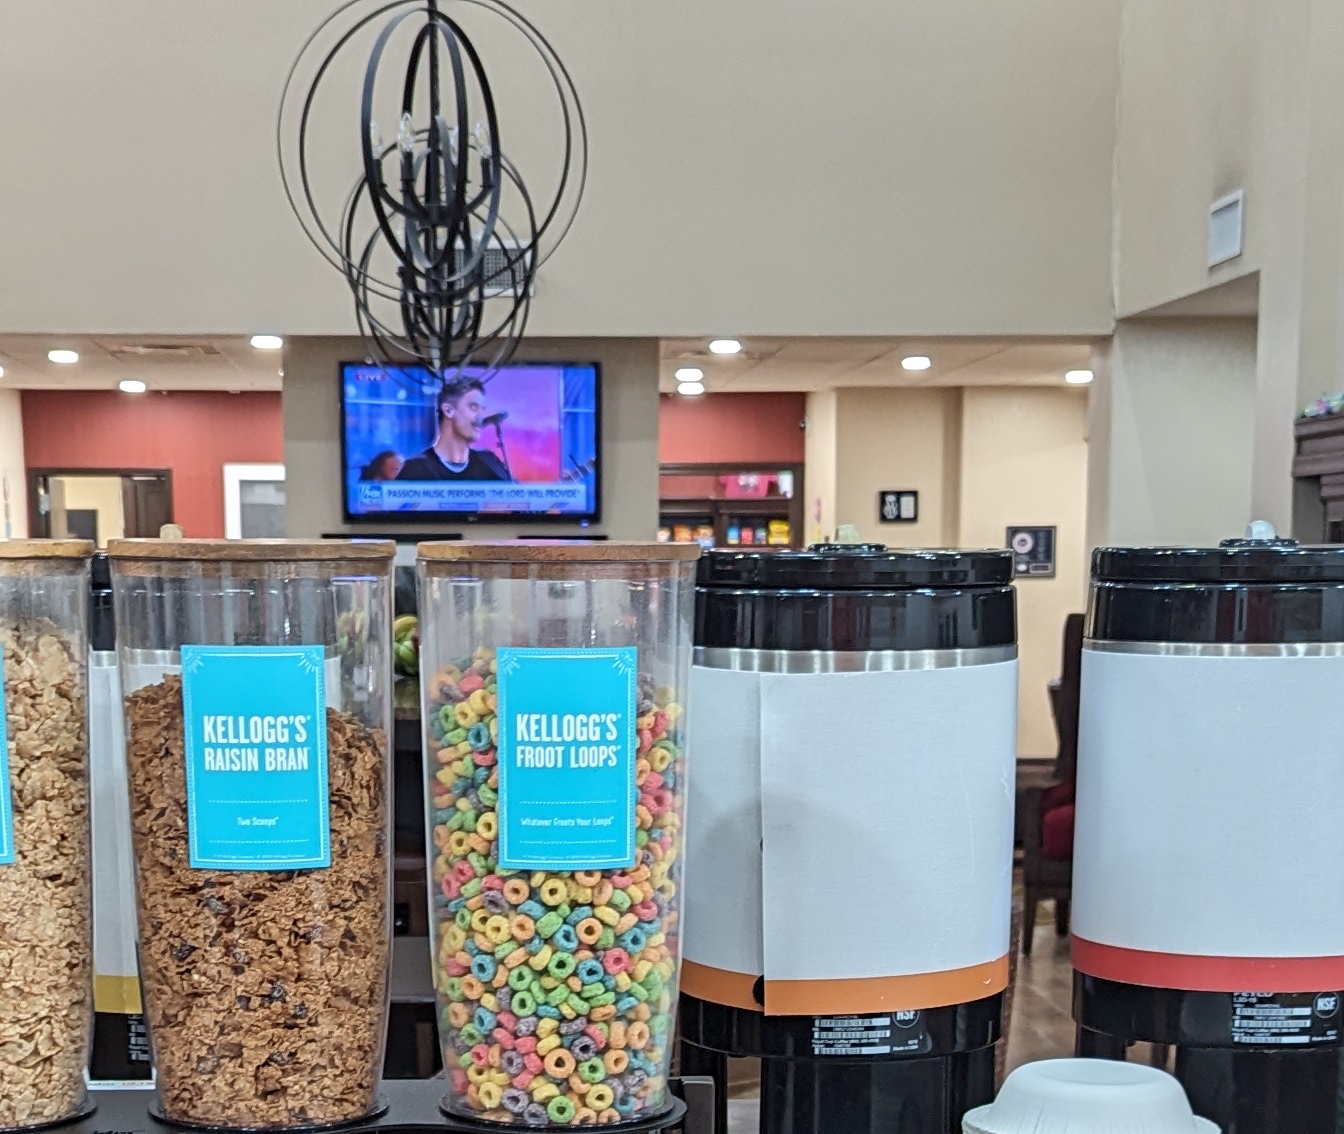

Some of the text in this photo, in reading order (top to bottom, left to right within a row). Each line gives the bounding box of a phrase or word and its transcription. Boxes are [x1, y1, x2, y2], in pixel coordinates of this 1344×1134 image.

[387, 489, 421, 498] PASSION
[422, 489, 445, 498] MUSIC
[447, 489, 485, 498] PERFORMS
[506, 489, 525, 498] LORD
[527, 489, 544, 498] WILL
[203, 715, 308, 744] KELLOGG'S
[516, 713, 618, 742] KELLOGG'S
[204, 747, 309, 771] RAISIN BRAN
[516, 744, 618, 768] FROOT LOOPS
[1317, 997, 1336, 1011] NSF
